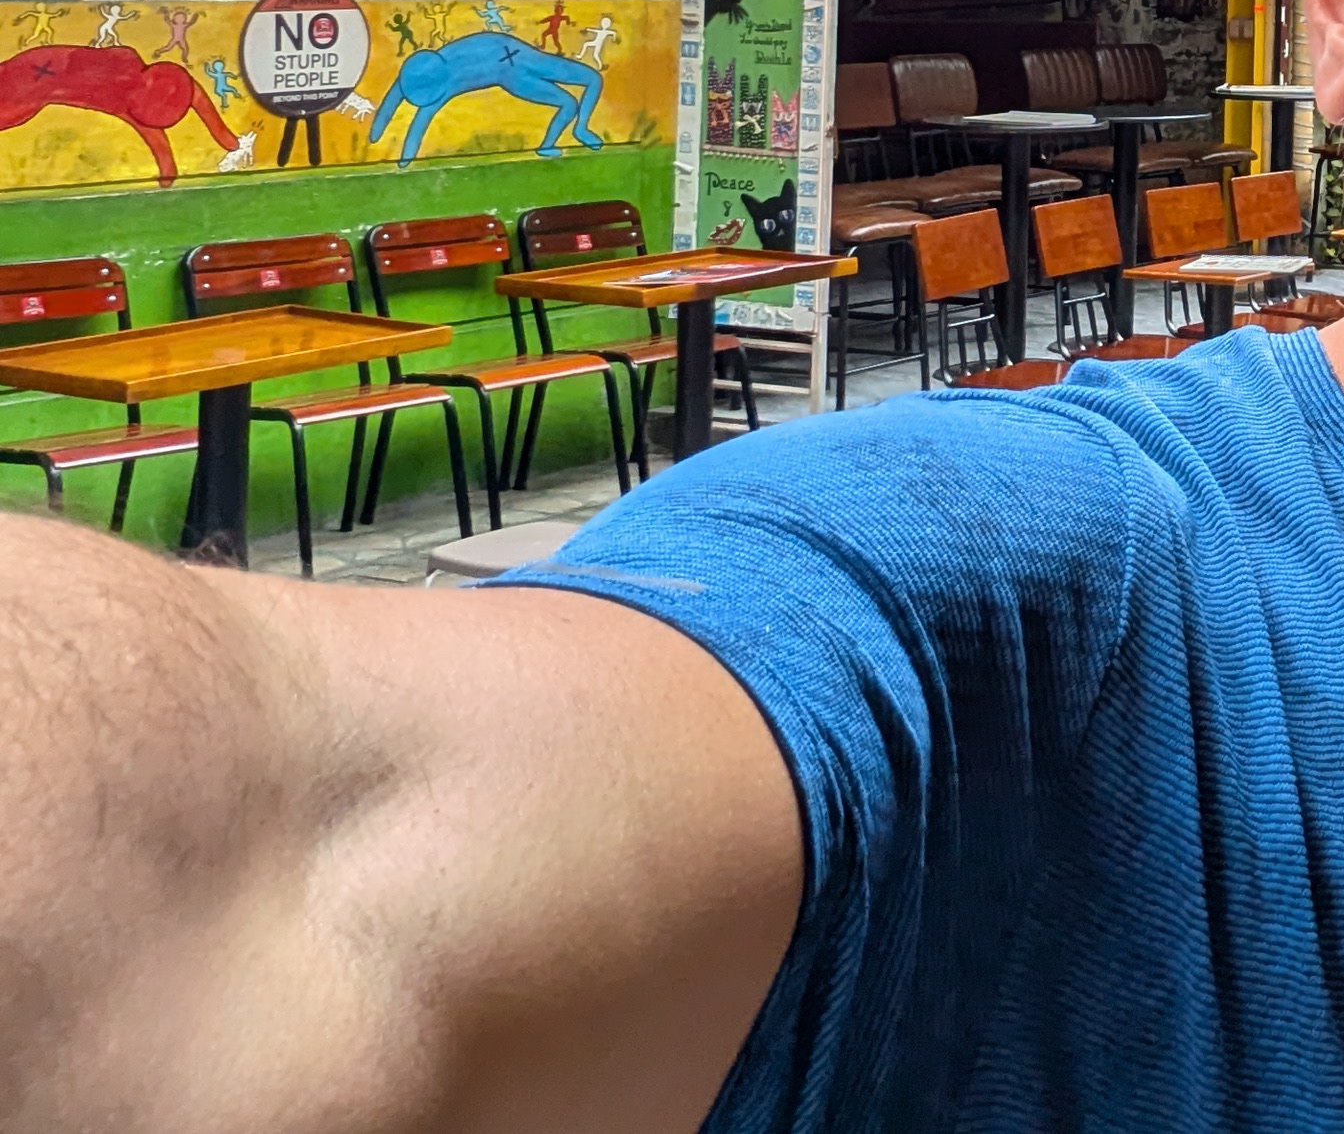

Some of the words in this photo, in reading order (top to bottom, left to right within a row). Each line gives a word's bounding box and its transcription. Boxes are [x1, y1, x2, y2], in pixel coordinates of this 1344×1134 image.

[274, 12, 339, 52] NO
[274, 53, 339, 70] STUPID
[273, 71, 339, 89] PEOPLE
[272, 94, 302, 103] BEYOND
[302, 93, 318, 101] THIS
[318, 91, 339, 99] POINT
[705, 172, 756, 196] Peace
